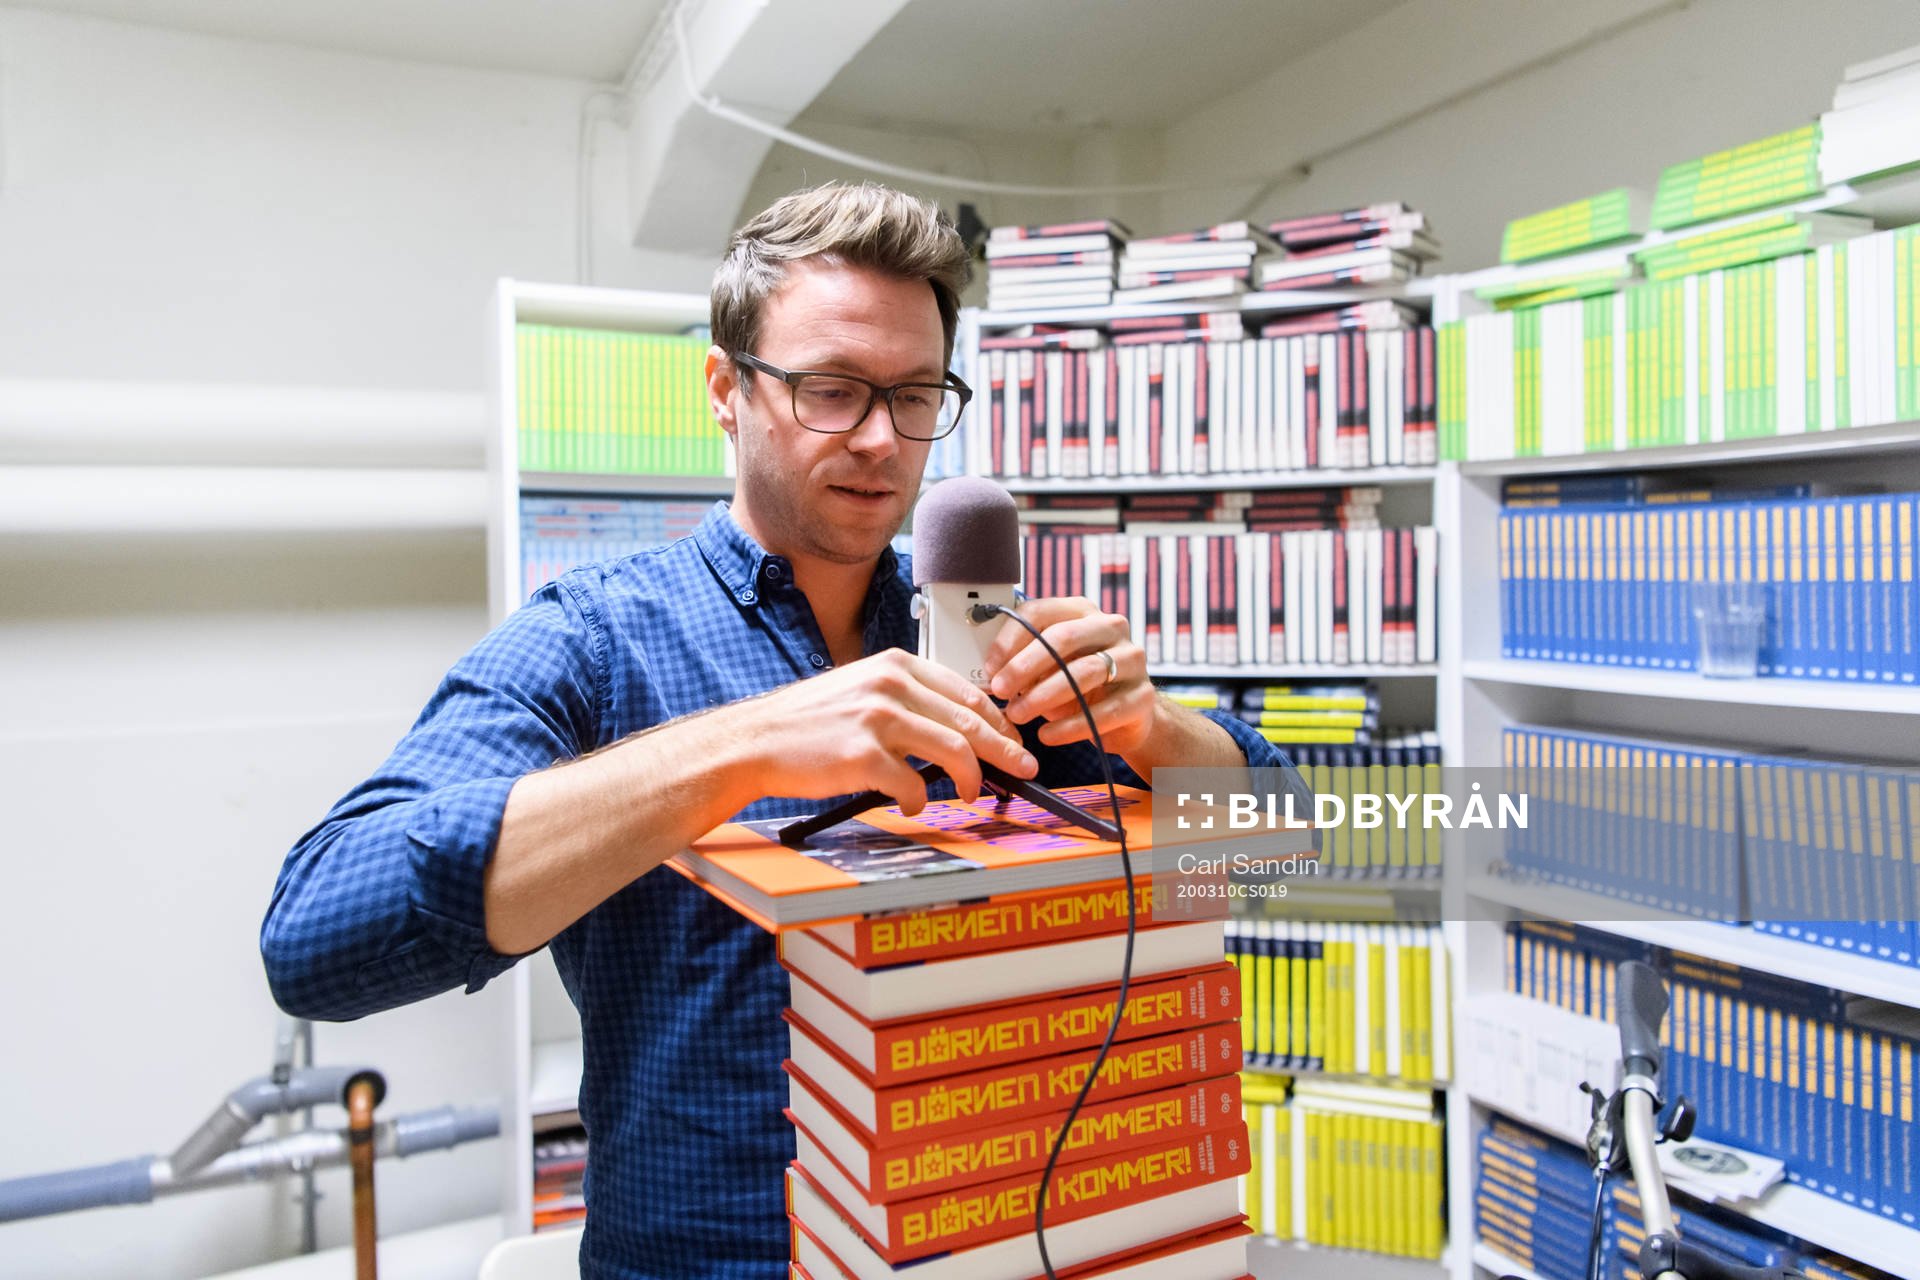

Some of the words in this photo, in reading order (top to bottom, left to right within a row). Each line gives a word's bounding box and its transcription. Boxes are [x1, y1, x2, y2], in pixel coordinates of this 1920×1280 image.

[1031, 884, 1168, 929] KOMMER!
[1048, 990, 1183, 1041] KOMMER!
[1048, 1043, 1183, 1097] KOMMER!
[1045, 1098, 1182, 1154] KOMMER!
[1058, 1146, 1192, 1205] KOMMER!
